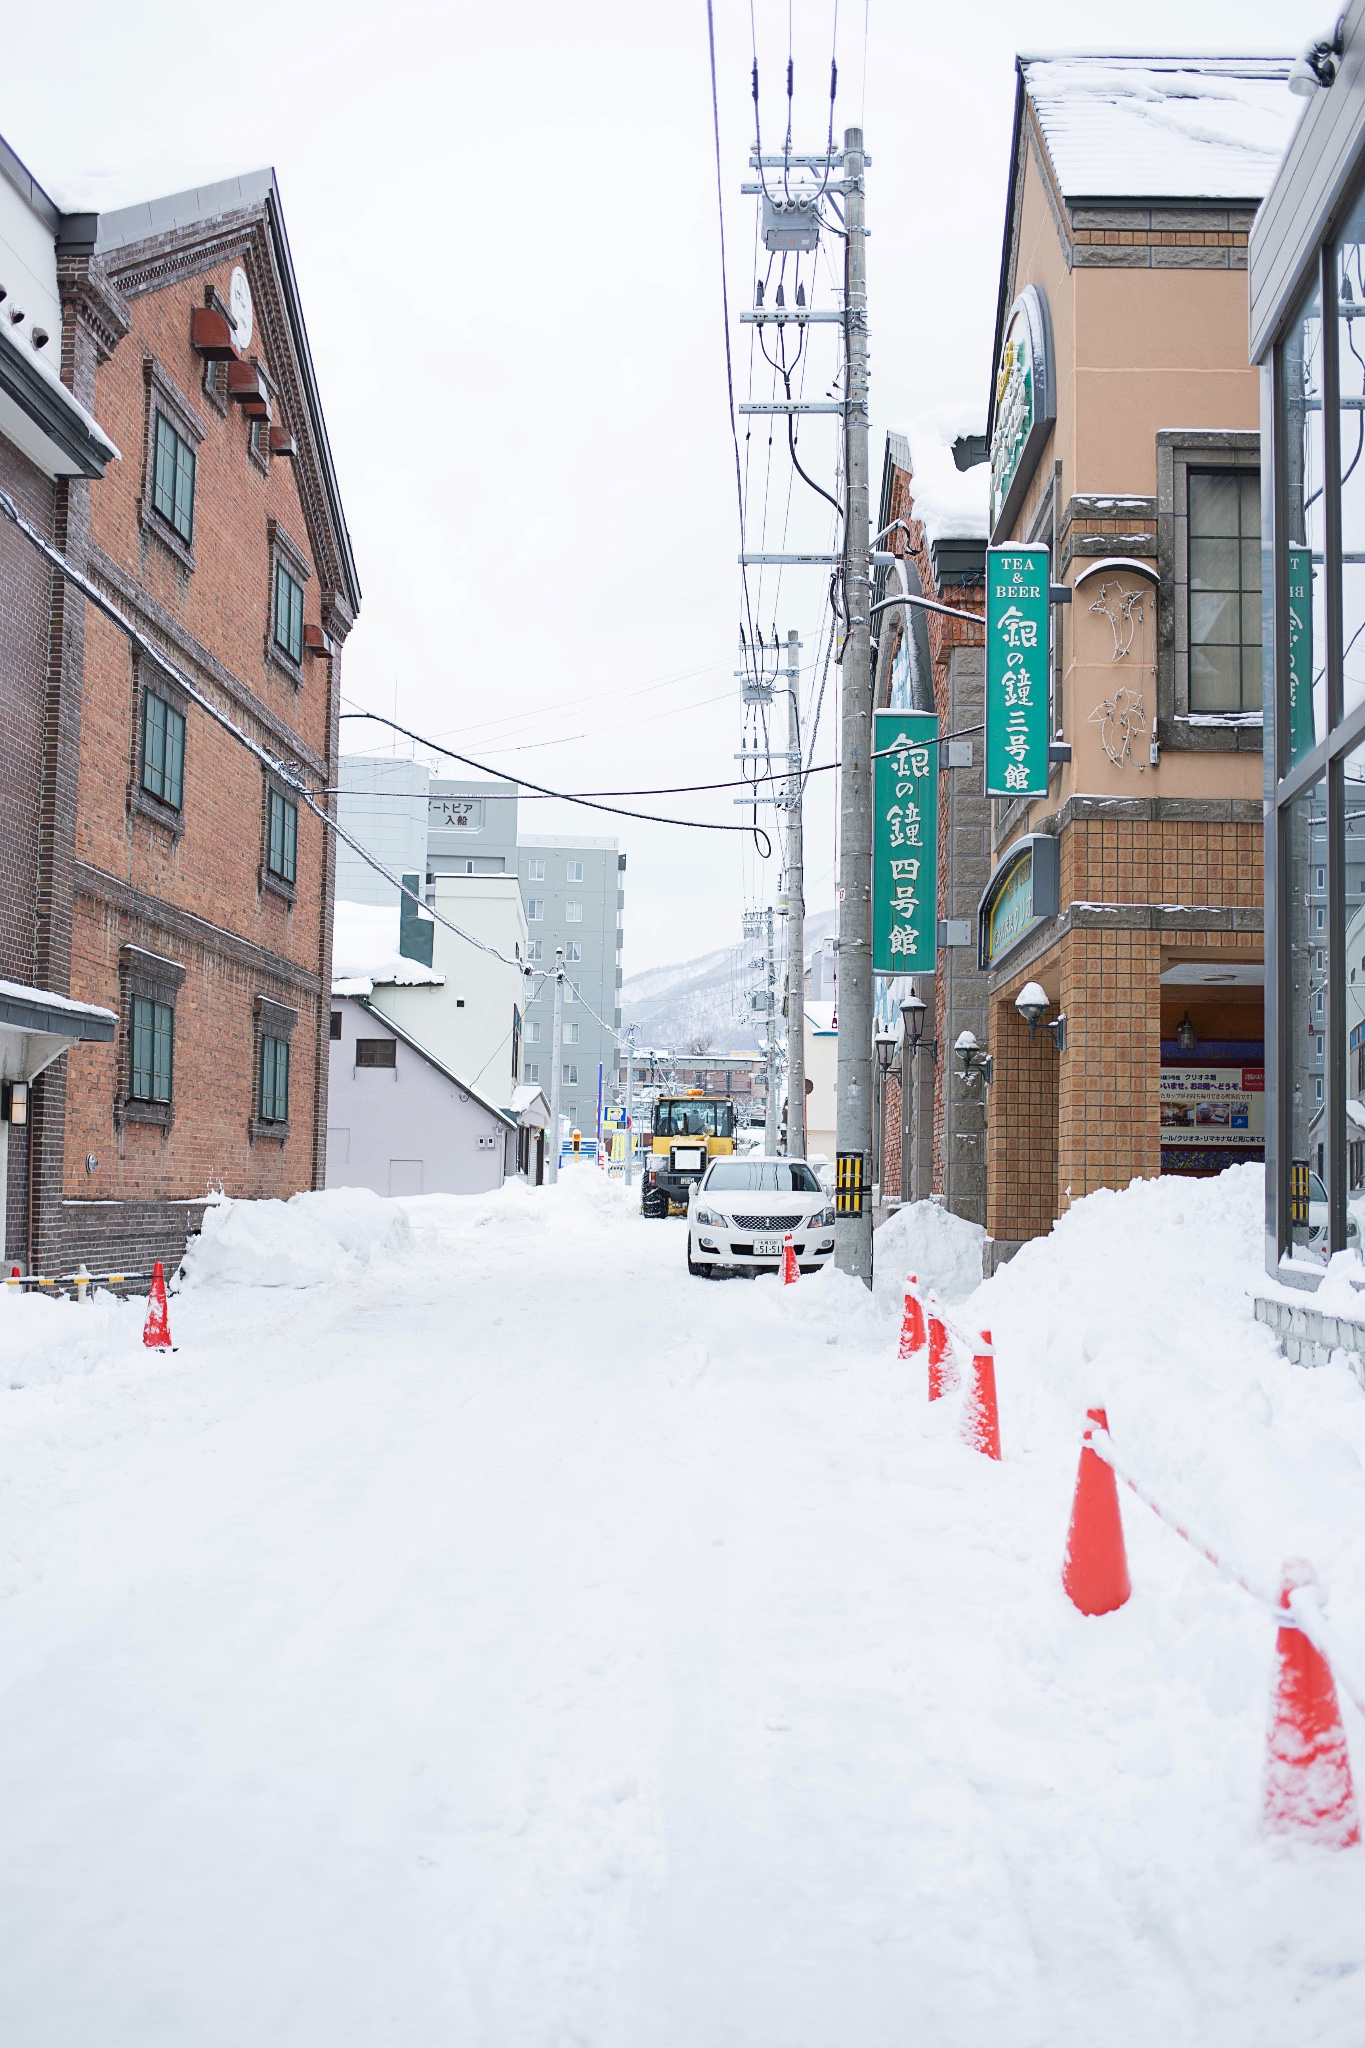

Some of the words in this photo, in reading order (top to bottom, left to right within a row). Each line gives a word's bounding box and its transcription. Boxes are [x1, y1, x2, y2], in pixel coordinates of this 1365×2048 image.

[1001, 558, 1036, 570] TEA
[1012, 573, 1024, 583] &
[995, 586, 1041, 598] BEER
[997, 605, 1038, 790] 銀の鐘三号館
[445, 815, 468, 826] 入船
[886, 732, 930, 956] 銀の鐘四号館
